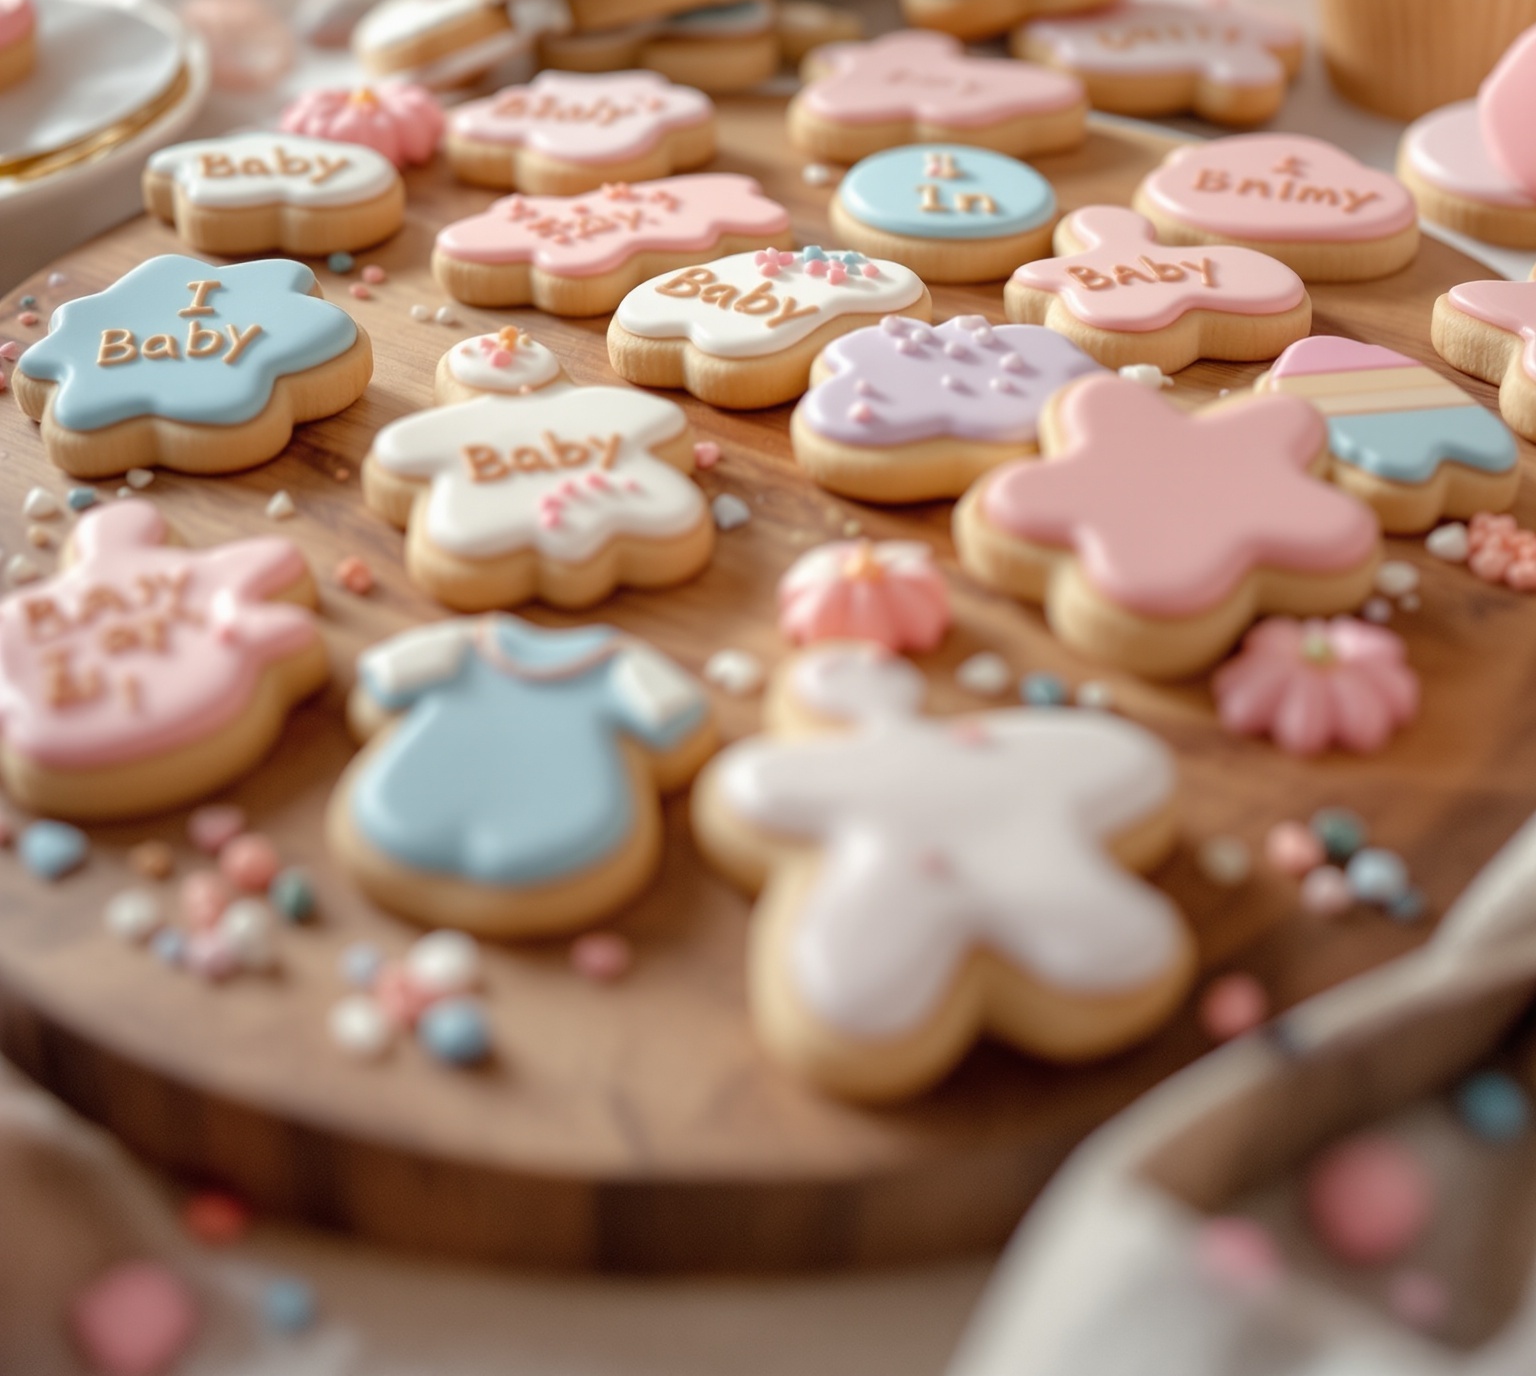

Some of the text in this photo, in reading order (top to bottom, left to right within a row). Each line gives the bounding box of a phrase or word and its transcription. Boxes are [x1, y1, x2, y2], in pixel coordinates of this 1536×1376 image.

[200, 146, 350, 185] Baby
[177, 280, 222, 318] I
[654, 267, 820, 329] Baby
[96, 320, 262, 366] Baby
[462, 430, 622, 485] Baby
